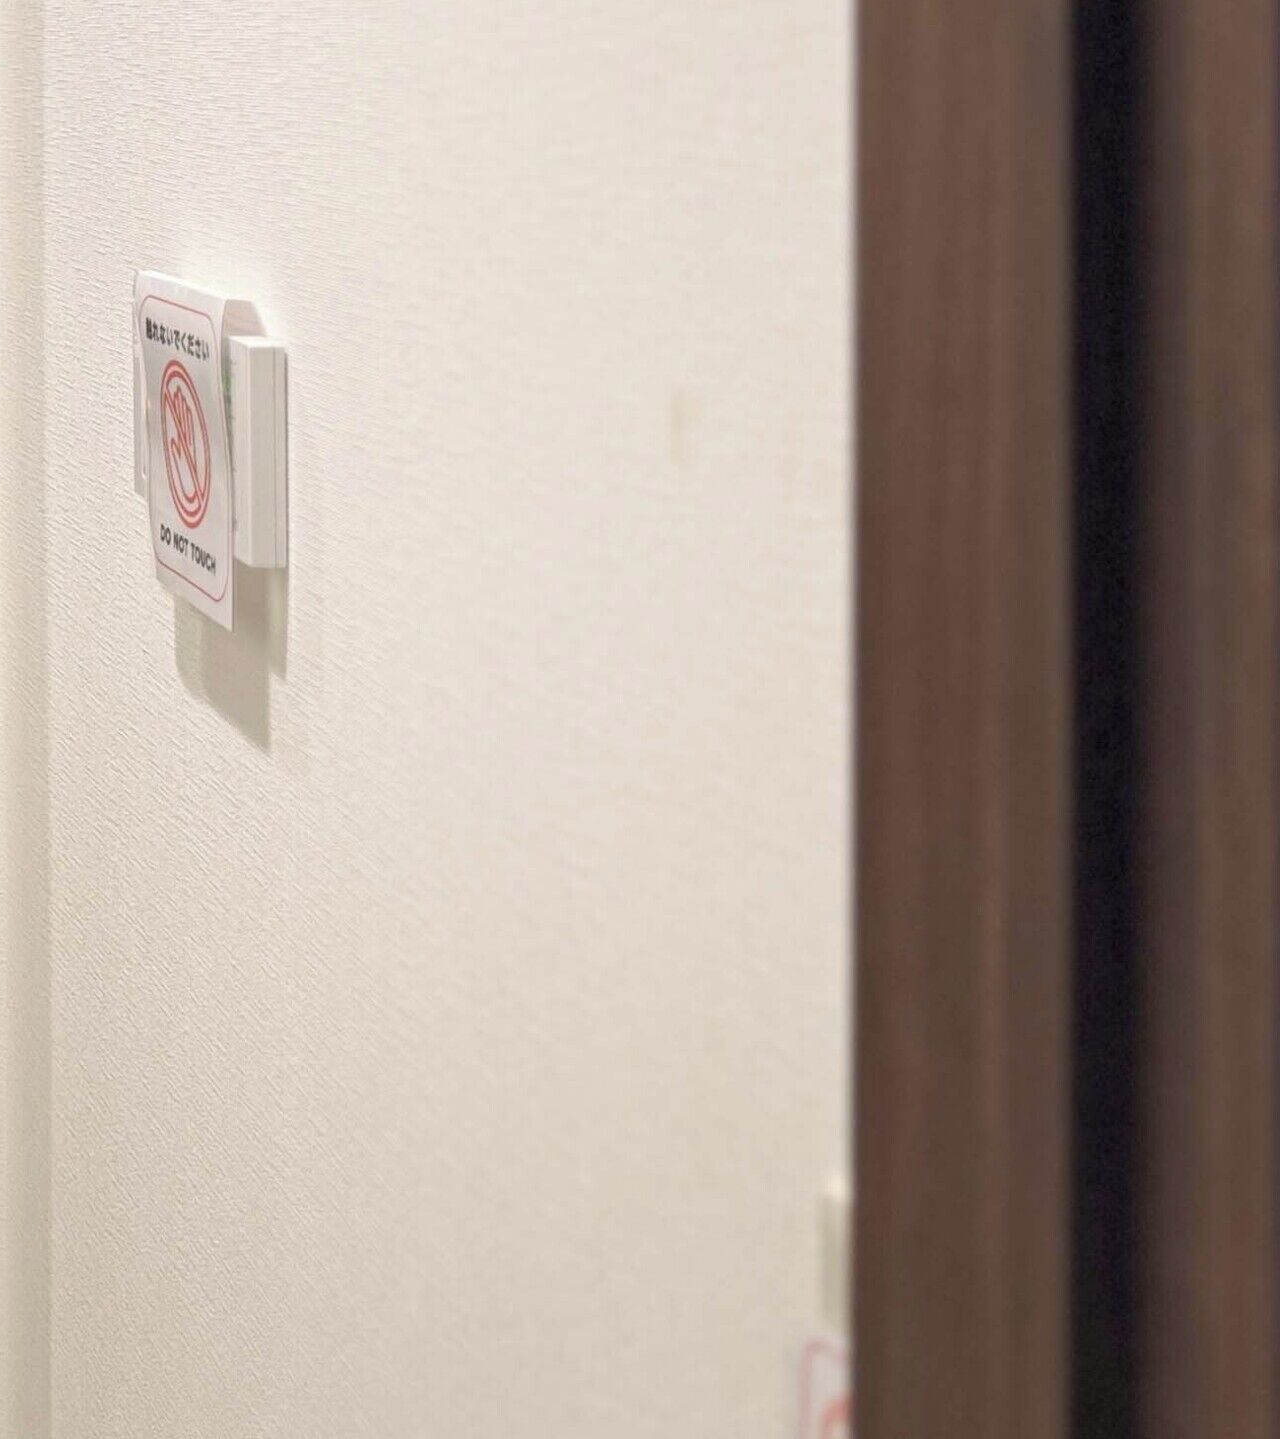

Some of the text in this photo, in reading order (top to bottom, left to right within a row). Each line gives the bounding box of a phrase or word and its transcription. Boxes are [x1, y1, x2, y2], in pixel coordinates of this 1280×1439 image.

[159, 523, 217, 577] DO NOT TOUCH
